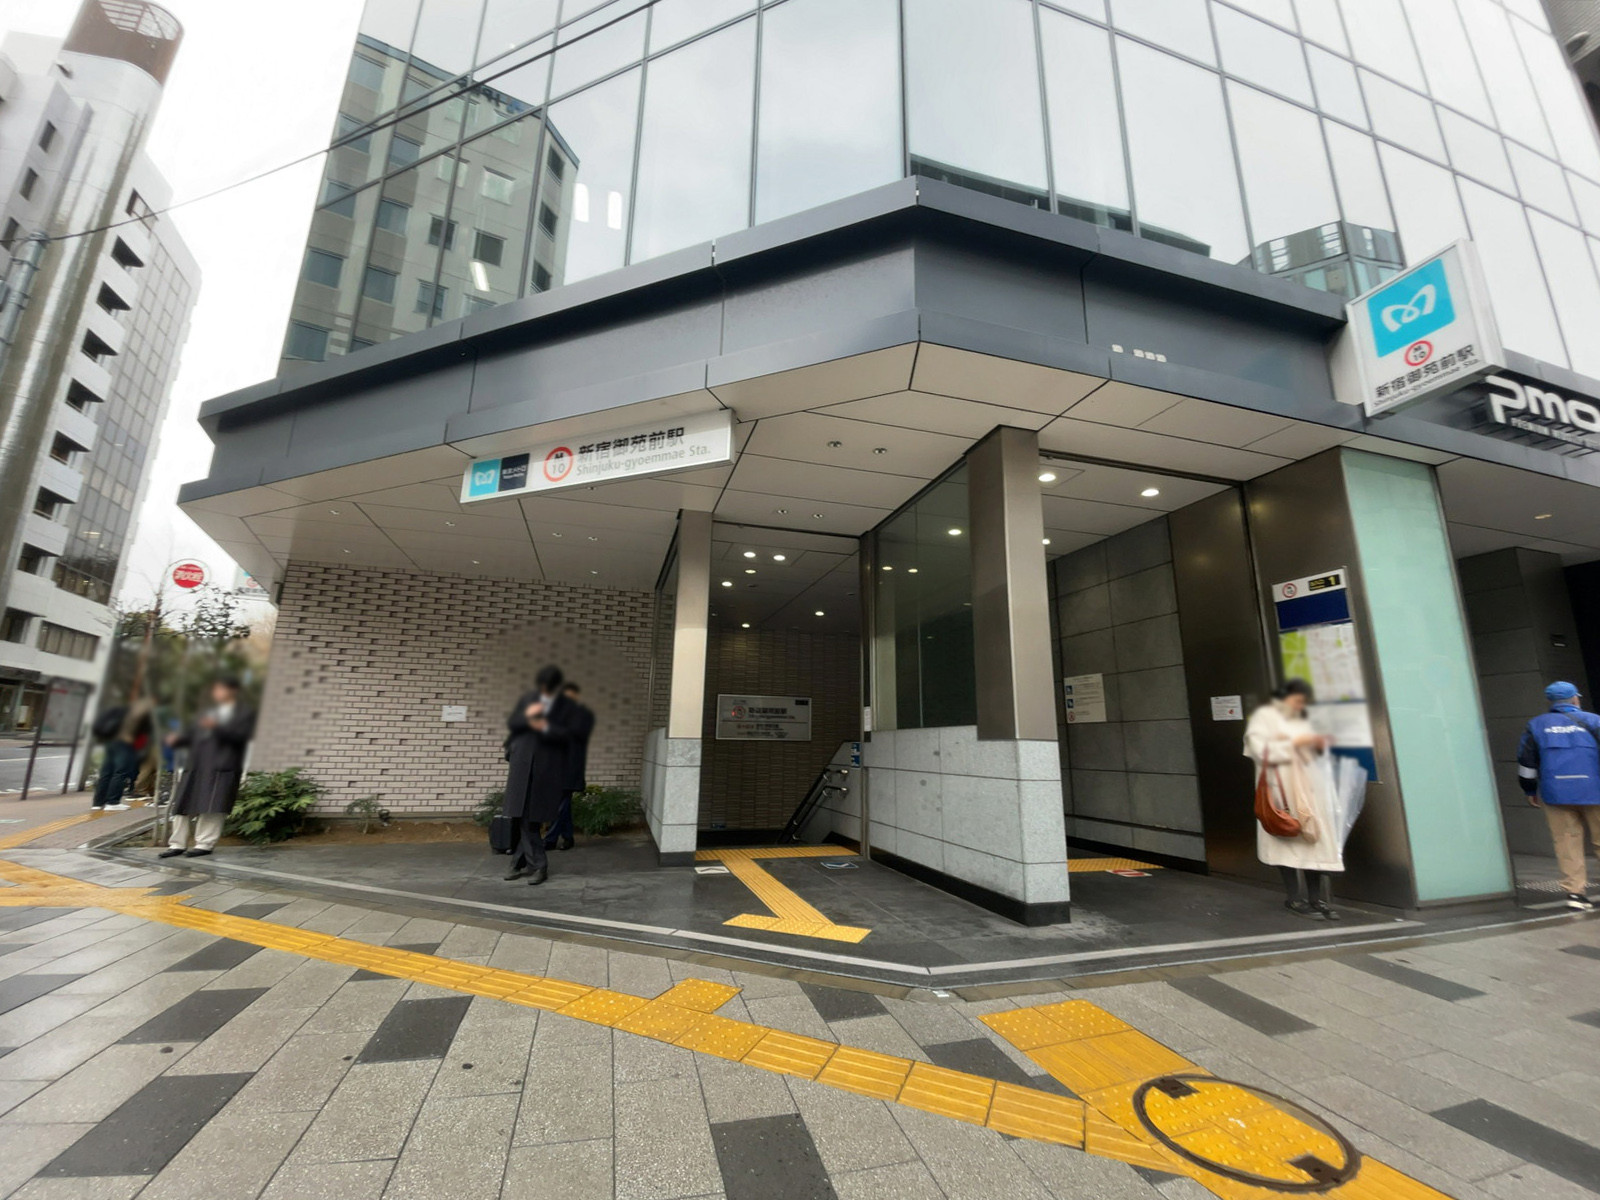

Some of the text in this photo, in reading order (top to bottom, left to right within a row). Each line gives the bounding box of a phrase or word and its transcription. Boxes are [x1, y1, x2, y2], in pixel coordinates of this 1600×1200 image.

[1375, 344, 1475, 398] 新宿御苑前駅
[576, 444, 712, 477] Shinjuku-gyoemmae Sta.
[578, 426, 685, 463] 新宿御苑前駅
[552, 463, 566, 475] 10
[1328, 576, 1336, 586] 1
